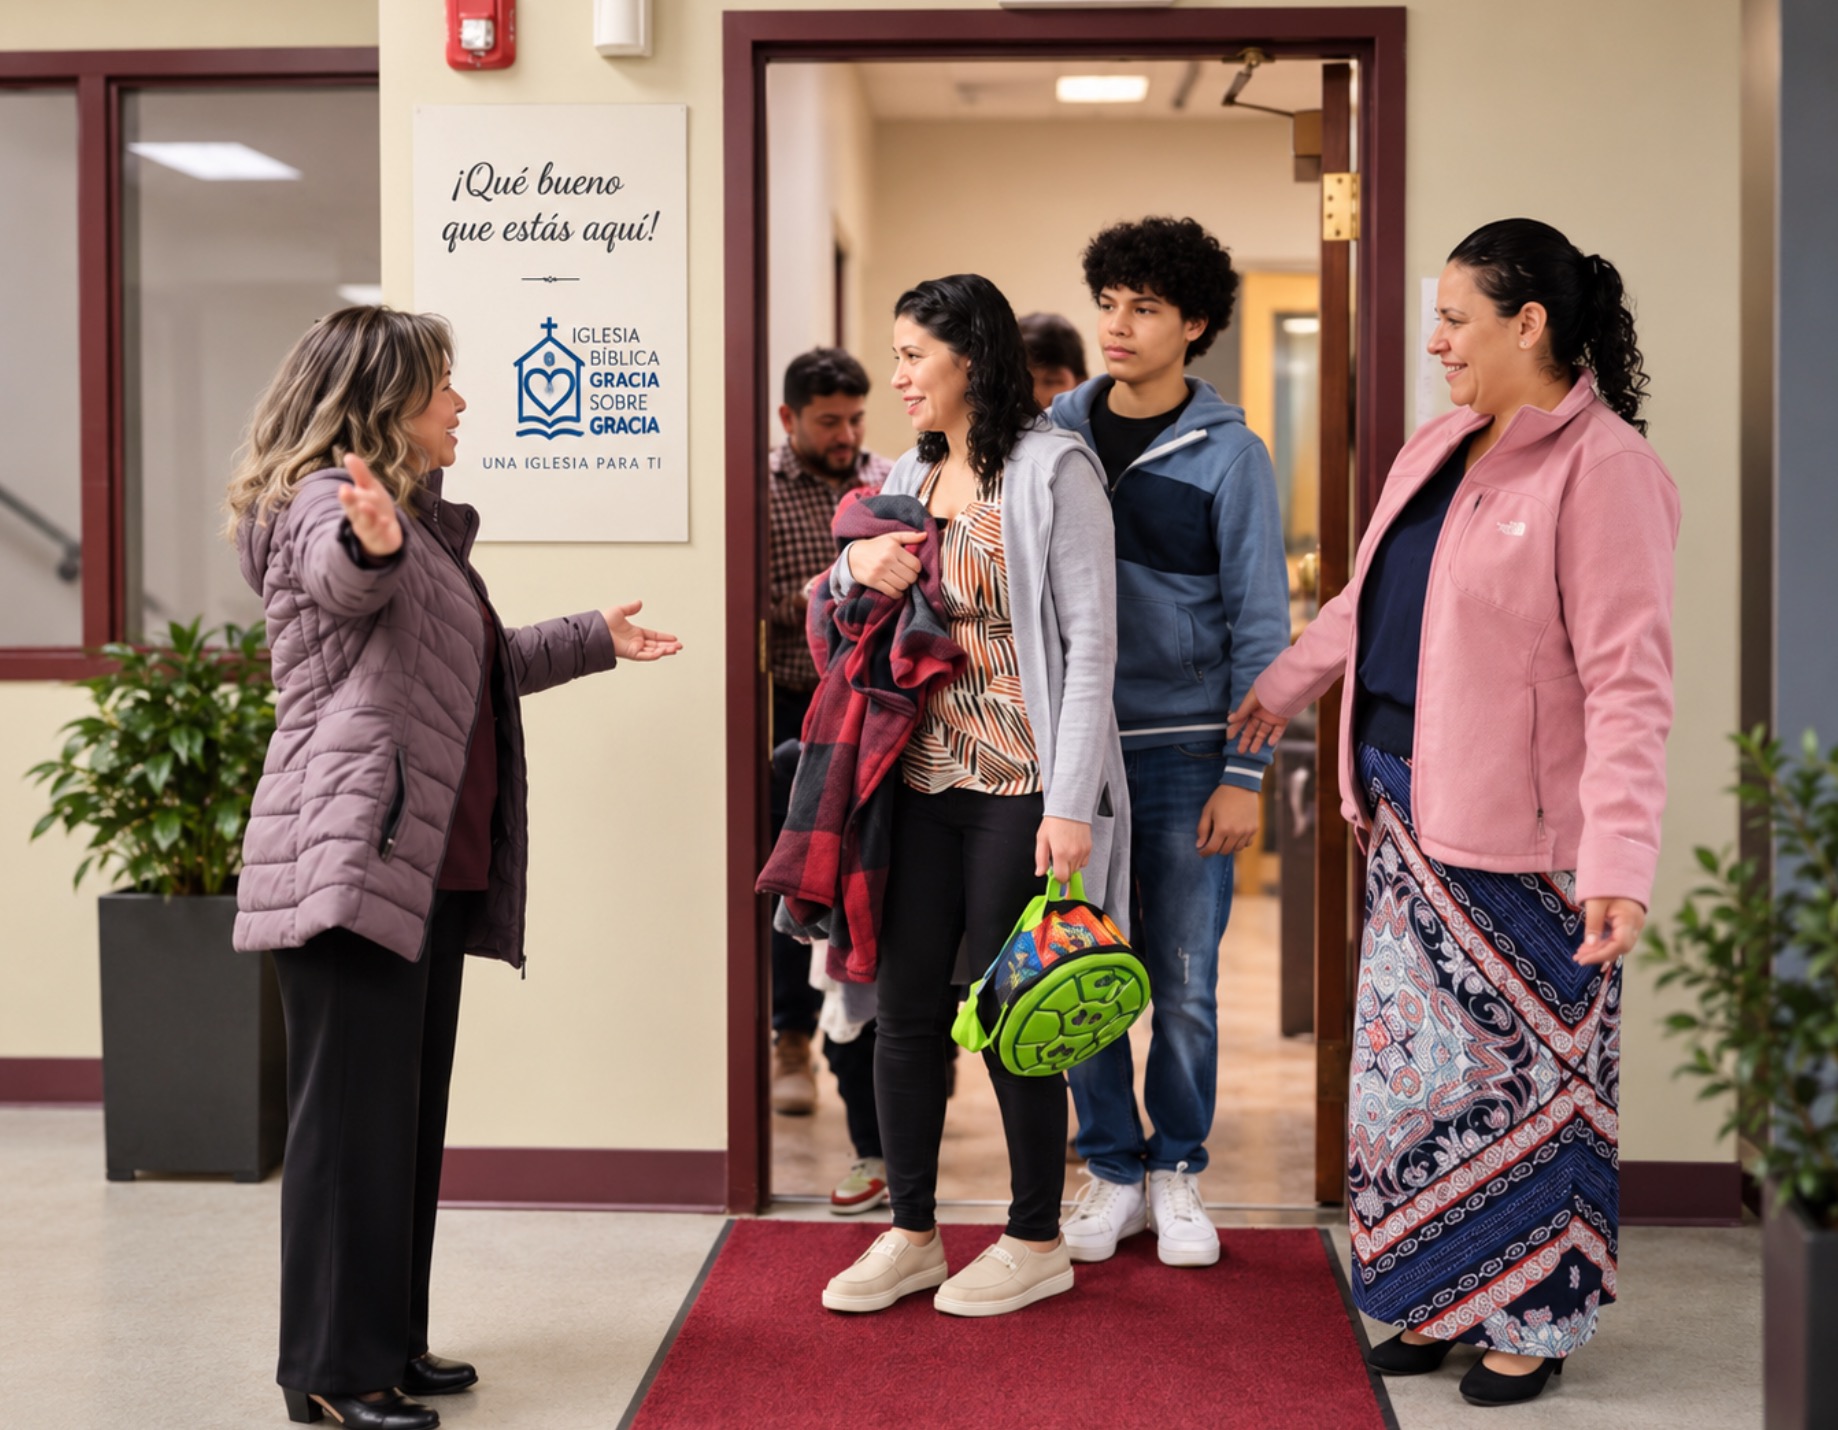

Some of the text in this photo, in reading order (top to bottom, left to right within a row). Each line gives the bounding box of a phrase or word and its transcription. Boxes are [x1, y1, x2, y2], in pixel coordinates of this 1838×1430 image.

[451, 160, 626, 203] ¡Qué bueno
[441, 209, 661, 254] que estás aquí!
[572, 326, 641, 345] IGLESIA
[590, 346, 661, 367] BÍBLICA
[589, 371, 661, 389] GRACIA
[589, 393, 649, 412] SOBRE
[589, 415, 661, 436] GRACIA
[482, 456, 662, 470] UNA IGLESIA PARA TI
